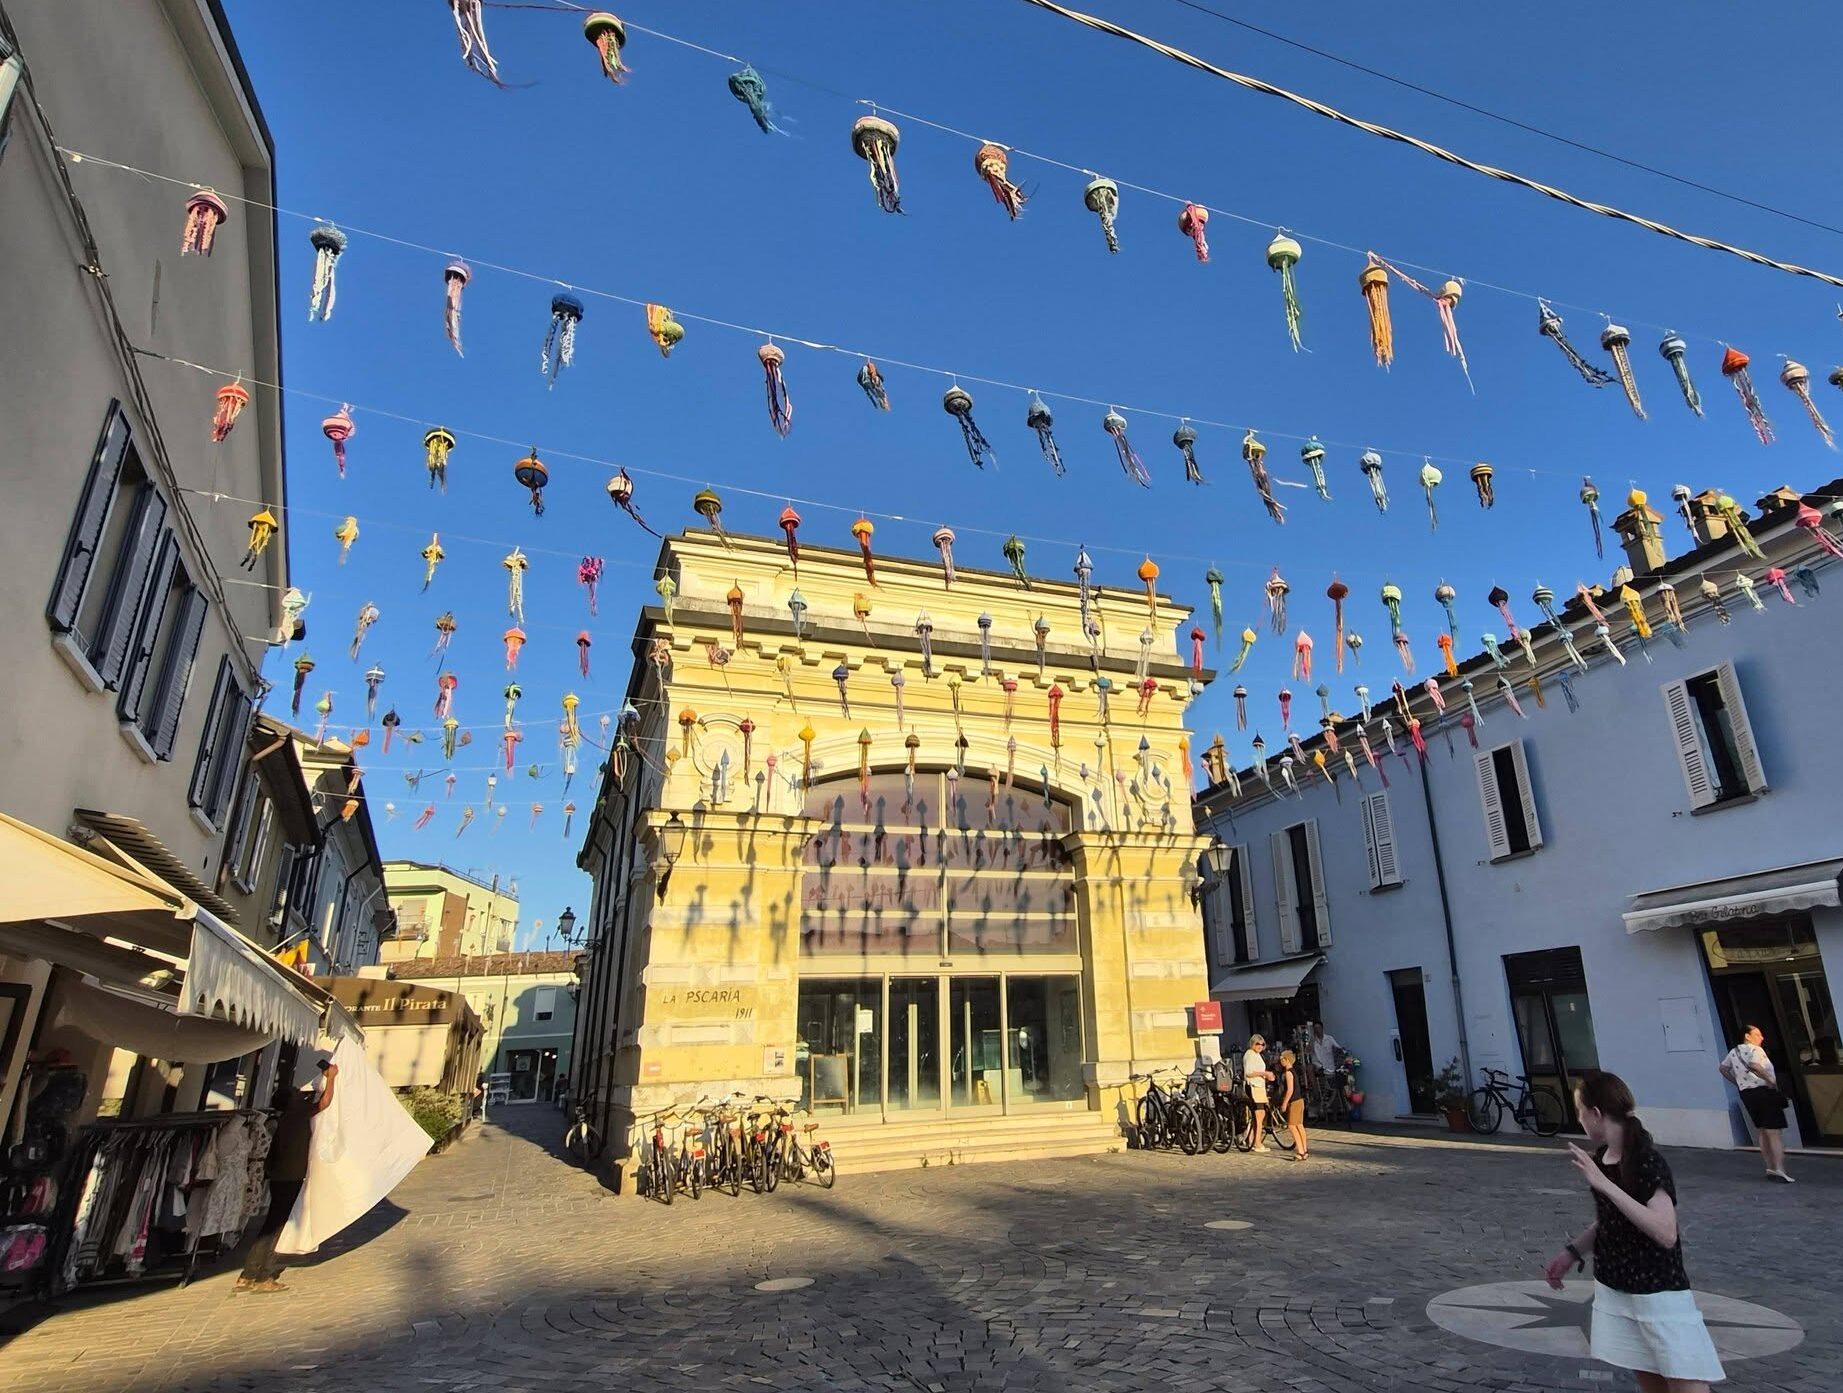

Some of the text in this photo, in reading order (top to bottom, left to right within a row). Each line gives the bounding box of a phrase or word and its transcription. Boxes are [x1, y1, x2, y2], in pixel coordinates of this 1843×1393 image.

[383, 998, 396, 1011] Il
[399, 999, 447, 1010] Pirata
[663, 995, 676, 1004] LA
[735, 1007, 753, 1019] 1911
